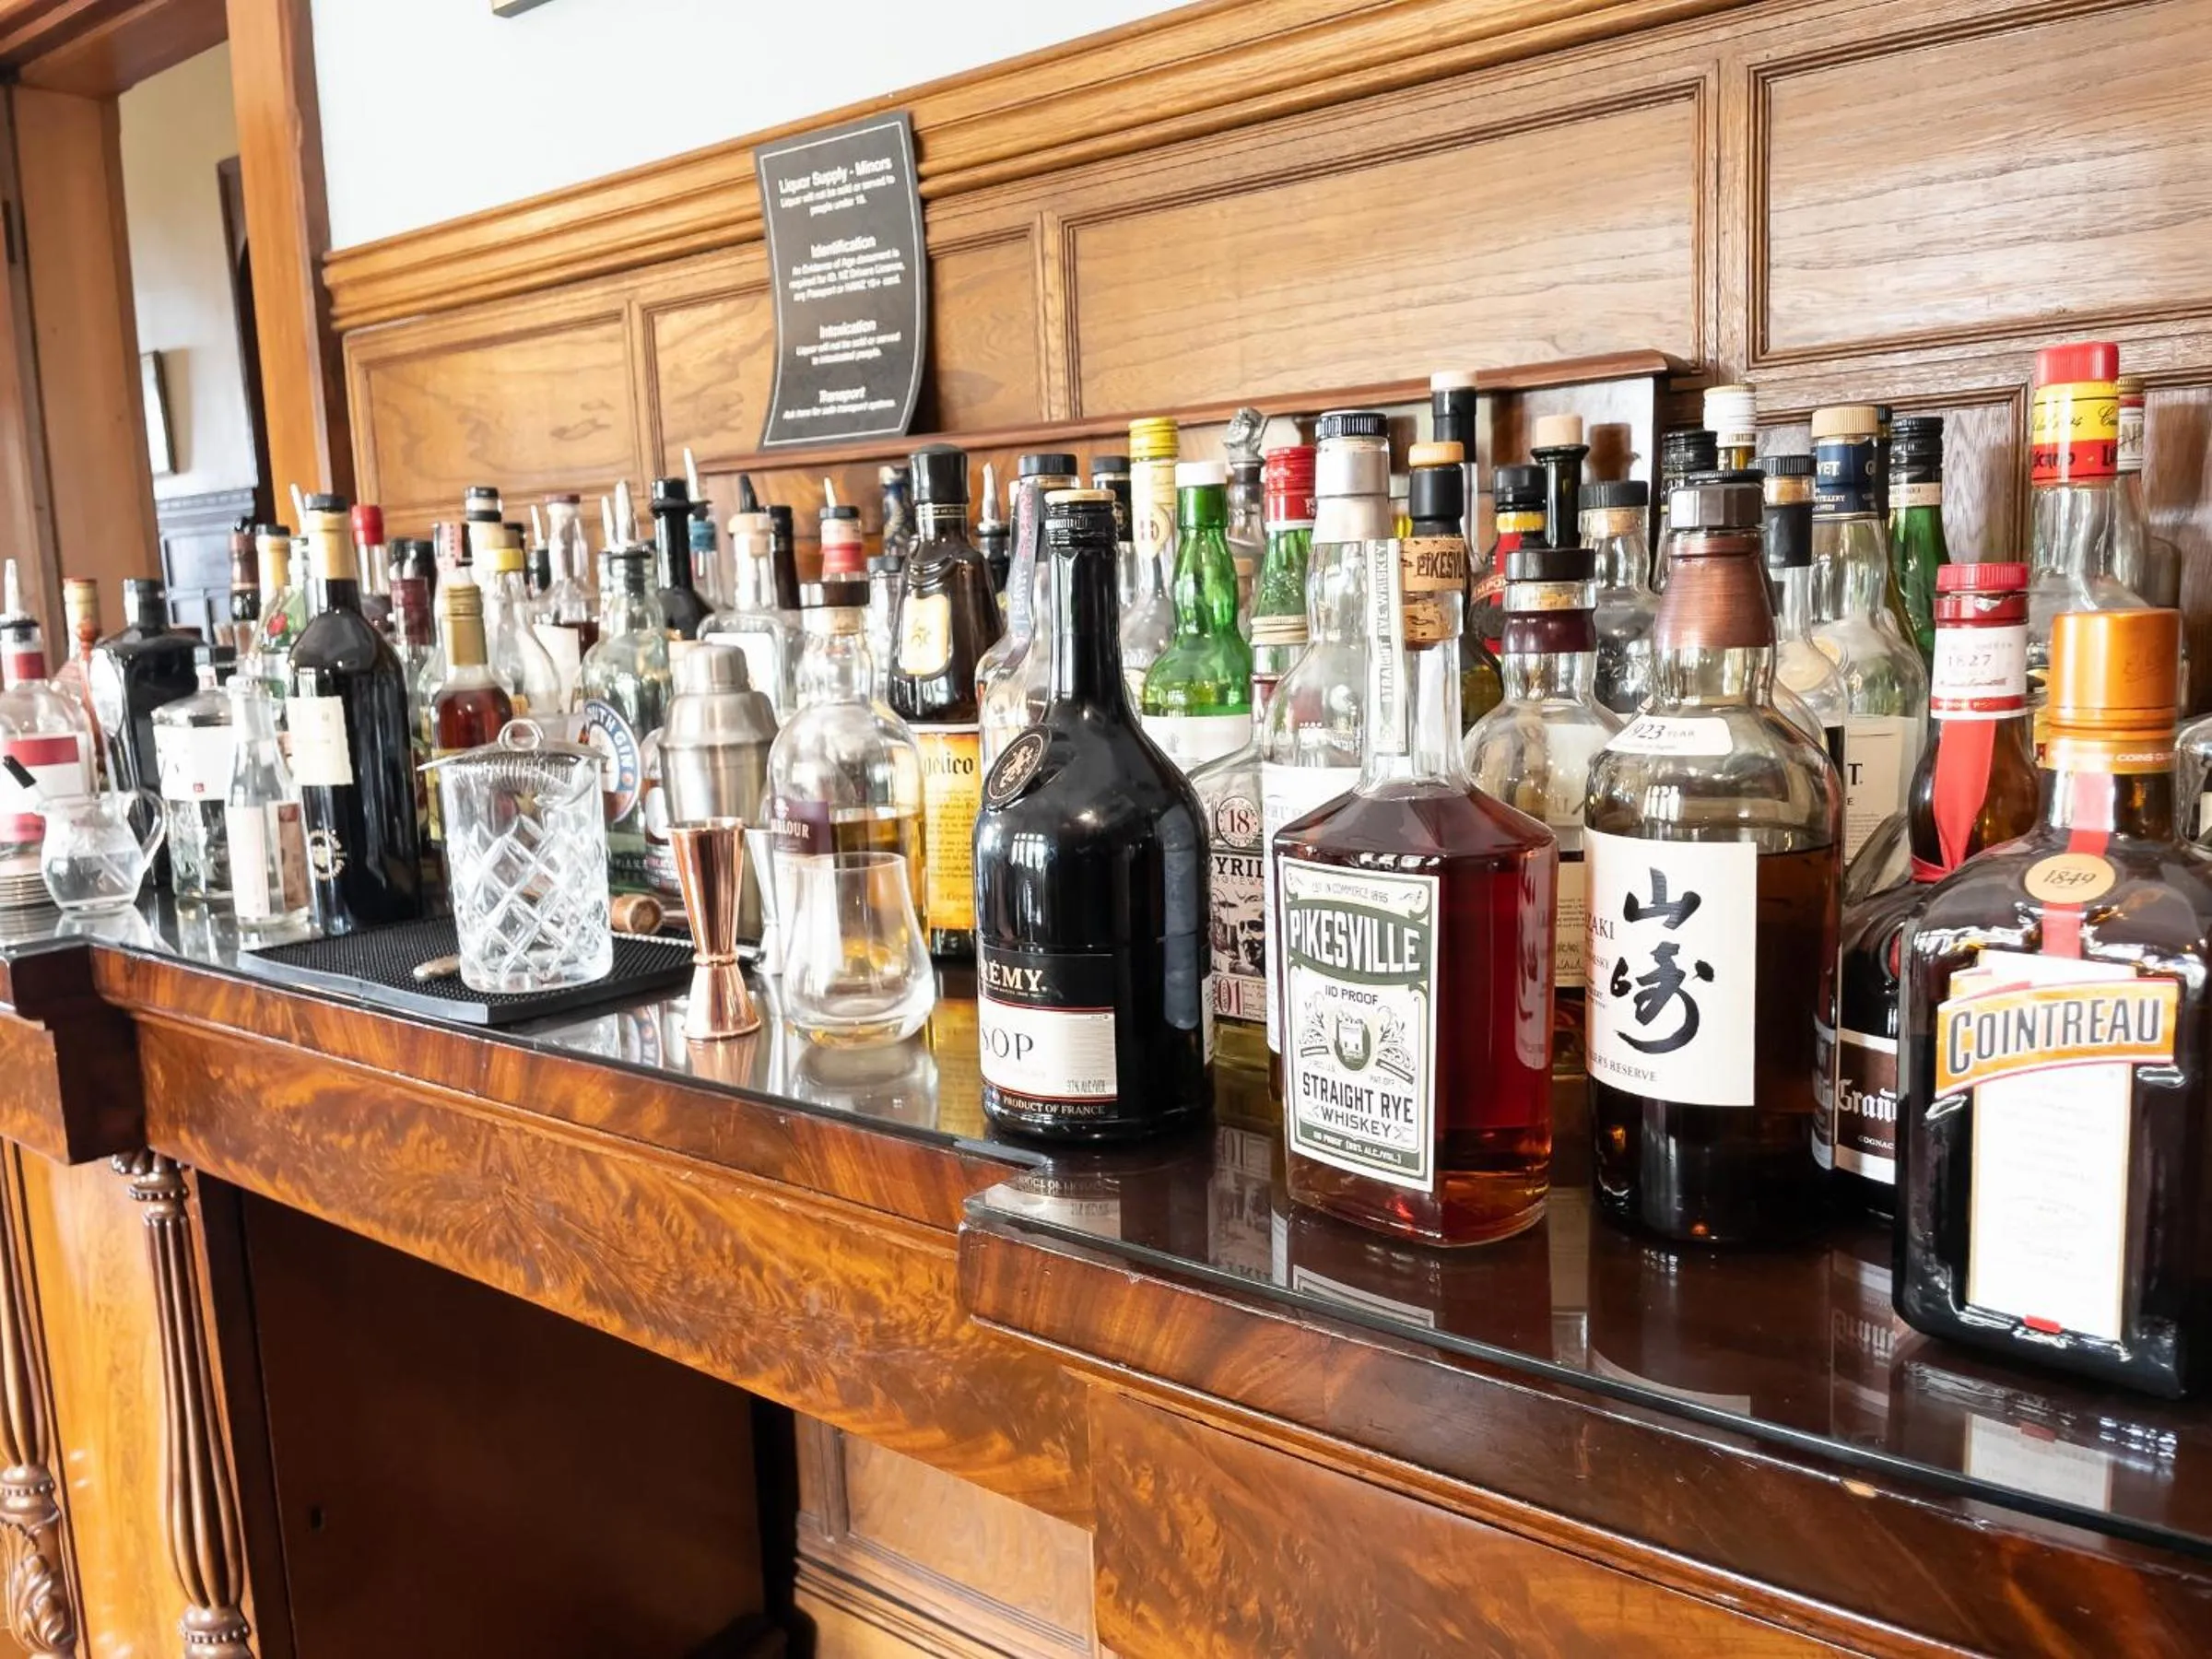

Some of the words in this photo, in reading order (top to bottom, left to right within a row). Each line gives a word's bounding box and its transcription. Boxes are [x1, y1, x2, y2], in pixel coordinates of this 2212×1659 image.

[779, 176, 810, 194] Liquor
[812, 166, 848, 185] Supply
[855, 158, 892, 176] Minors
[811, 236, 876, 258] Identification
[819, 319, 877, 339] Intoxication
[818, 385, 866, 404] Transport
[1375, 545, 1390, 606] WHISKEY
[1230, 809, 1251, 835] 18
[2043, 869, 2096, 885] 1849
[1290, 908, 1421, 973] PIKESVILLE
[1325, 984, 1338, 997] 110
[1341, 988, 1379, 1006] PROOF
[1949, 999, 2160, 1075] COINTREAU
[1609, 1058, 1657, 1084] RESERVE
[1003, 1096, 1043, 1113] PRODUCT
[1045, 1104, 1060, 1115] OF
[1061, 1105, 1106, 1116] FRANCE
[1303, 1071, 1374, 1115] STRAIGHT
[1381, 1093, 1414, 1124] RYE
[1320, 1105, 1392, 1139] WHISKEY
[1858, 1135, 1895, 1150] COGNAC
